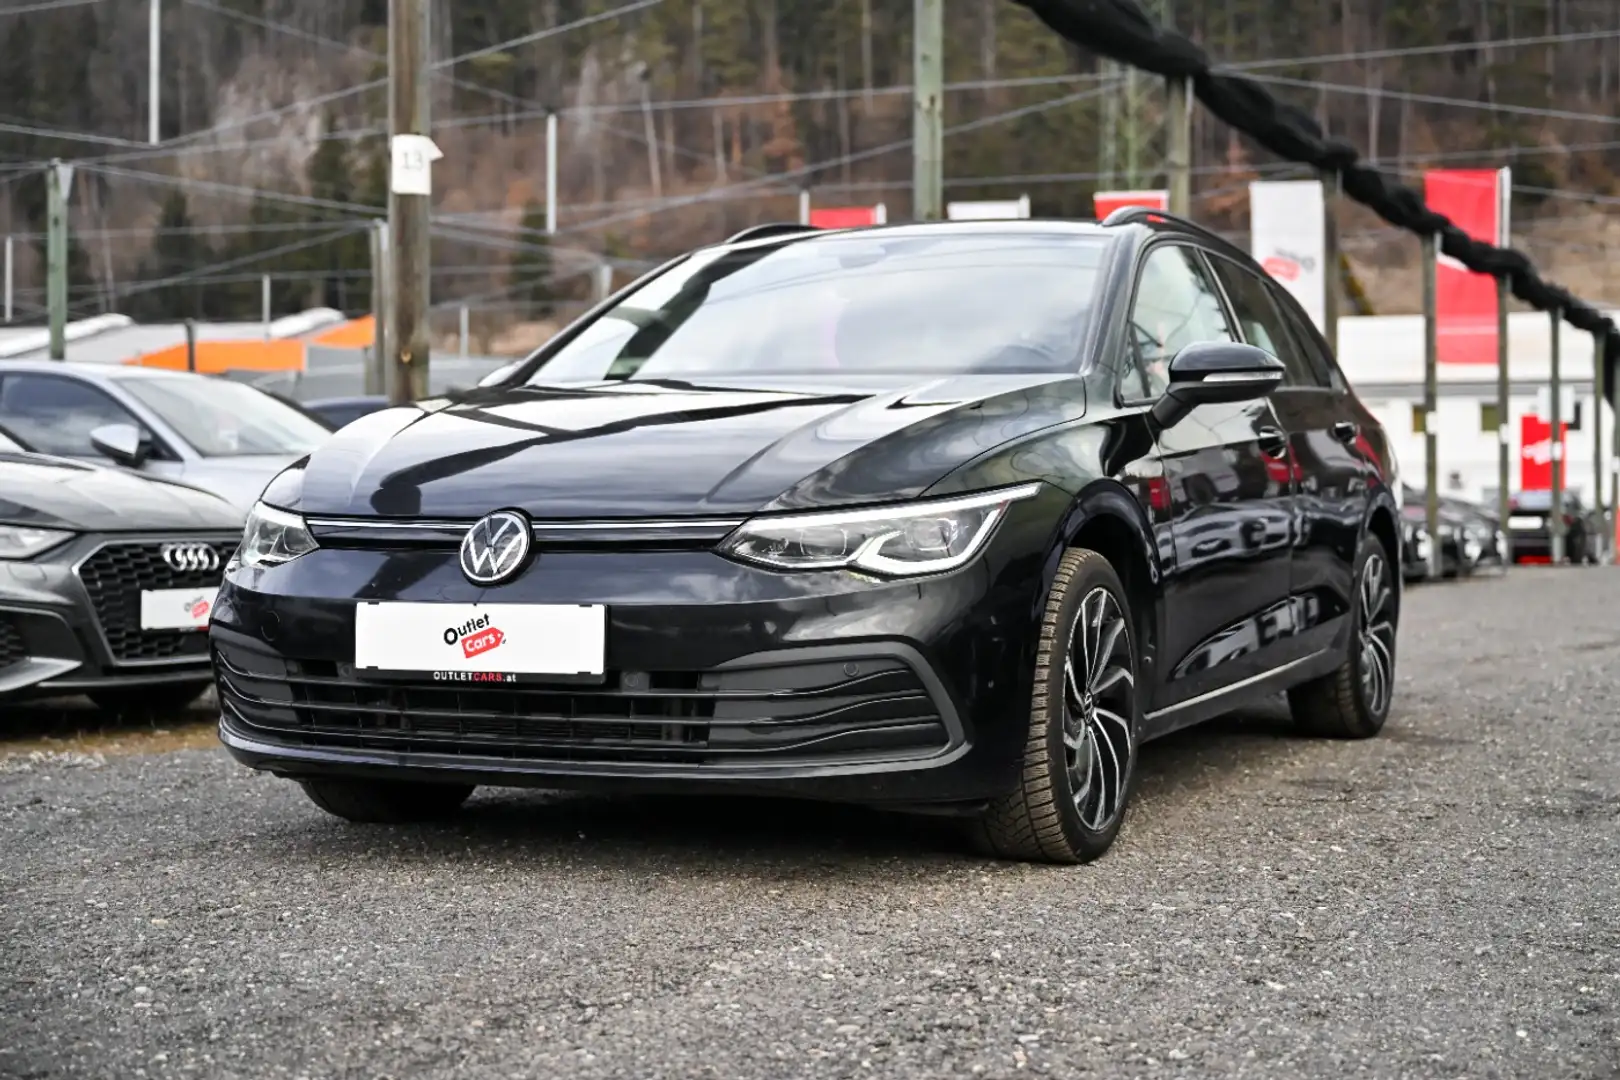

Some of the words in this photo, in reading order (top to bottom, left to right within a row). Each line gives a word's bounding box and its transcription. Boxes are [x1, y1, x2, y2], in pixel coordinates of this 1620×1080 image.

[402, 150, 424, 171] 13
[443, 613, 490, 646] Outlet
[465, 633, 497, 652] Cars
